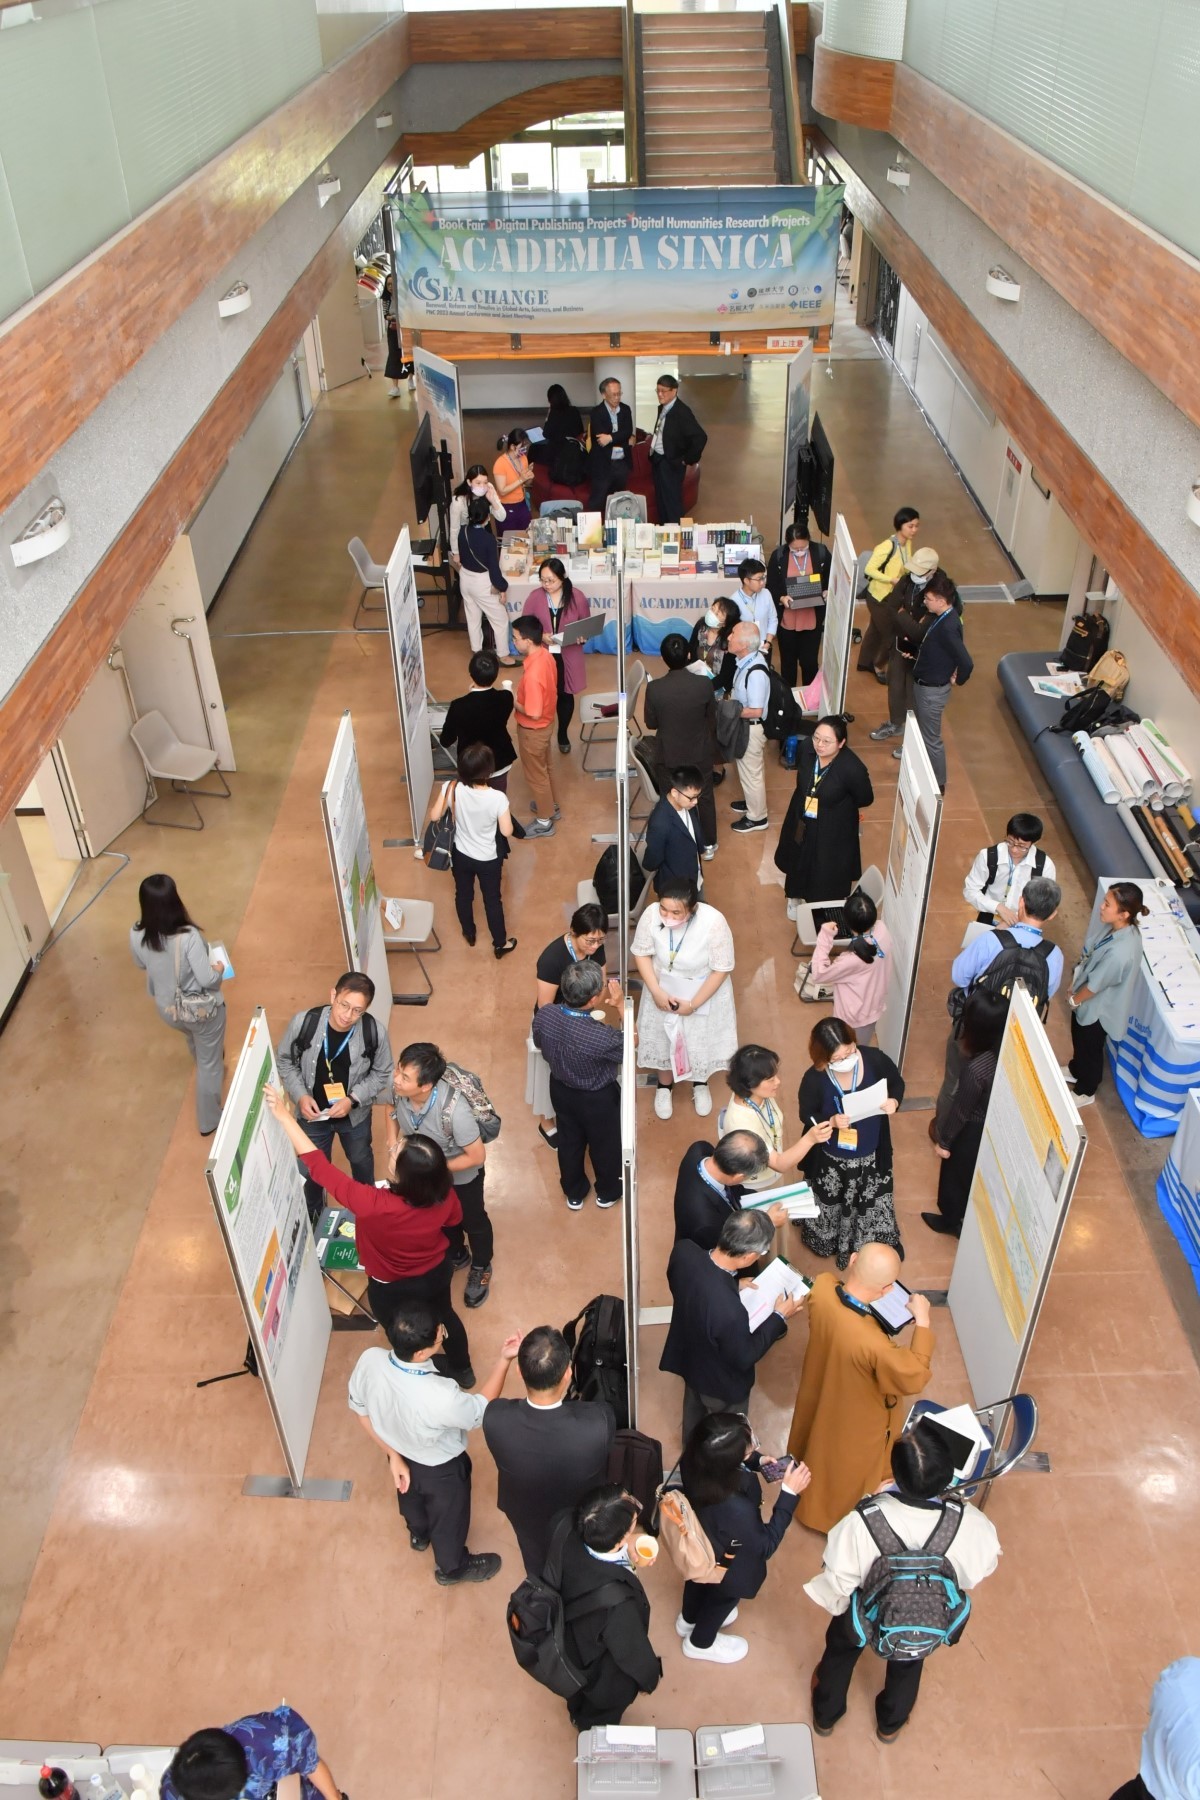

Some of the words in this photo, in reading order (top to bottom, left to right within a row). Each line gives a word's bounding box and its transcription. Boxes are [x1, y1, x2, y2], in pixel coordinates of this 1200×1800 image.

[438, 218, 464, 230] Book
[466, 218, 485, 231] Fair
[495, 218, 528, 232] Digital
[532, 218, 584, 232] Publishing
[586, 217, 626, 232] Projects
[632, 216, 664, 232] Digital
[666, 216, 722, 229] Humanities
[726, 215, 769, 228] Research
[772, 214, 810, 230] Projects
[438, 234, 645, 273] ACADEMIA
[657, 233, 794, 270] SINICA
[472, 288, 548, 305] CHANGE
[800, 300, 822, 309] IEEE
[640, 597, 709, 609] ACADEMIA
